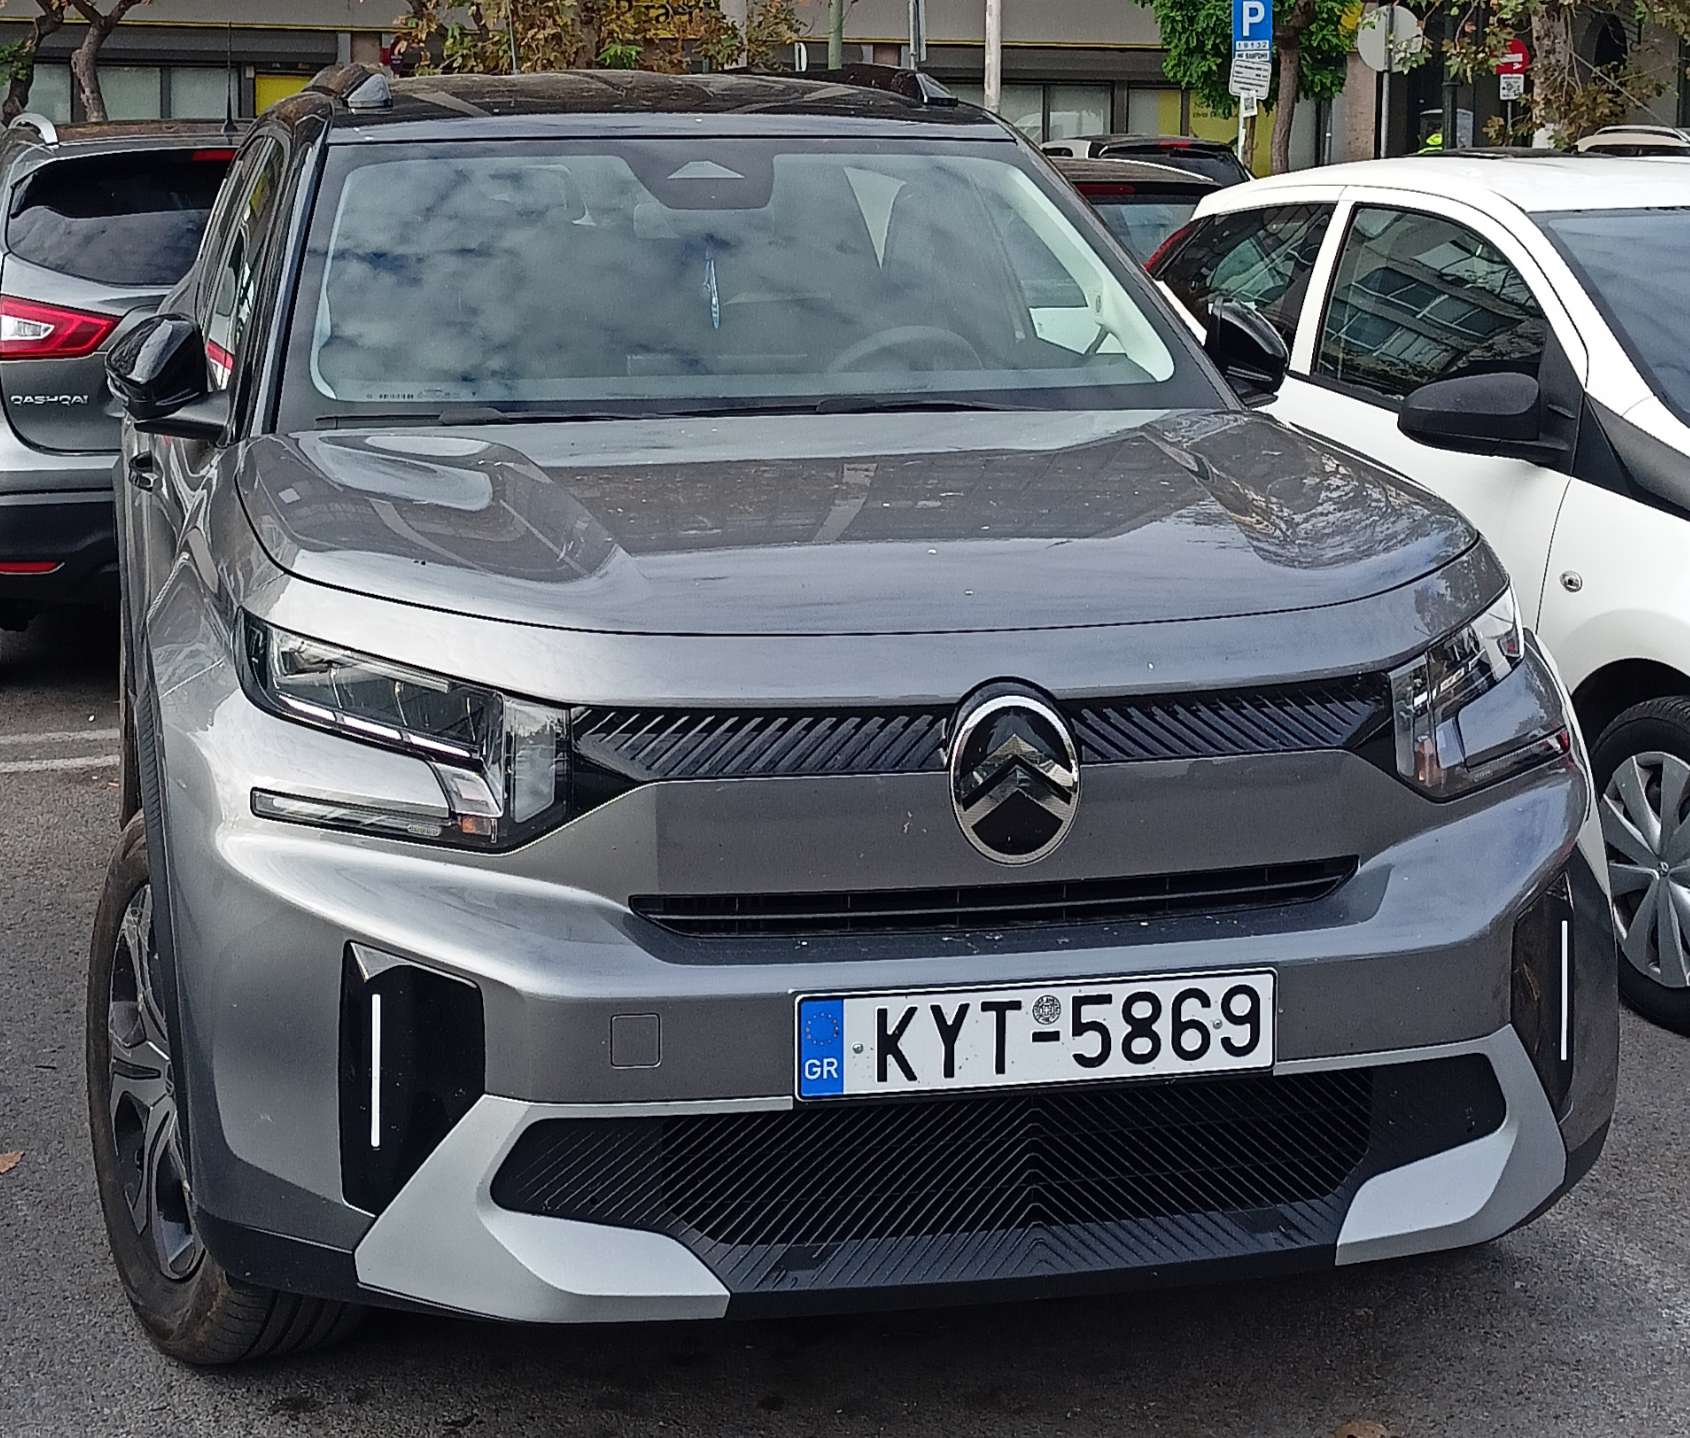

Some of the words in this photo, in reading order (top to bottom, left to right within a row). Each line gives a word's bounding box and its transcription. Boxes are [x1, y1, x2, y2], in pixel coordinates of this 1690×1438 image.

[1243, 1, 1265, 36] P
[875, 983, 1261, 1083] KYT-5869
[804, 1058, 839, 1081] GR
